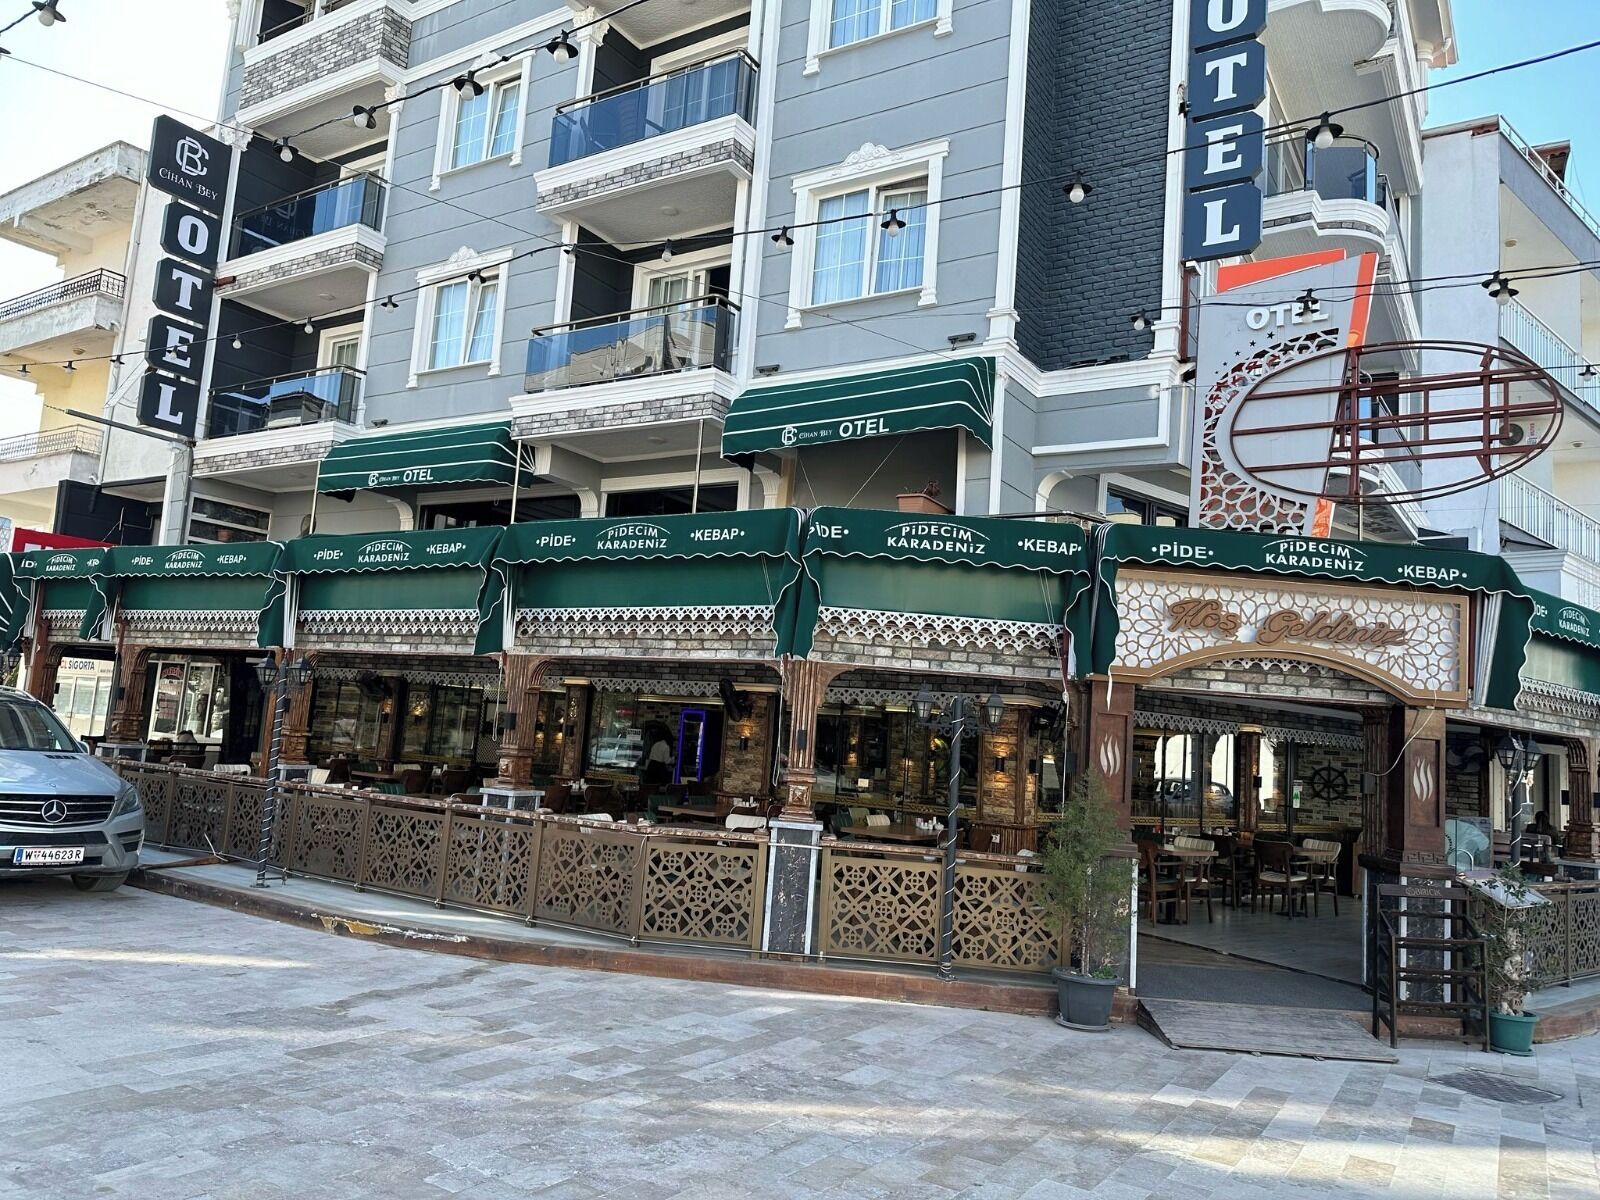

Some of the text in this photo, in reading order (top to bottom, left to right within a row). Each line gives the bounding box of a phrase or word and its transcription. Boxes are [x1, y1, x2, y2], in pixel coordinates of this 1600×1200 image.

[839, 417, 890, 437] OTEL
[403, 469, 434, 482] OTEL
[540, 533, 573, 547] PİDE
[694, 528, 740, 541] KEBAP
[316, 548, 340, 560] PİDE
[429, 543, 462, 555] KEBAP
[1024, 538, 1079, 556] KEBAP
[134, 556, 152, 565] PİDE
[219, 554, 245, 564] KEBAP
[1159, 541, 1207, 559] PİDE
[1403, 565, 1461, 581] KEBAP
[1168, 599, 1408, 646] Hoş Geldiniz
[25, 851, 34, 860] W
